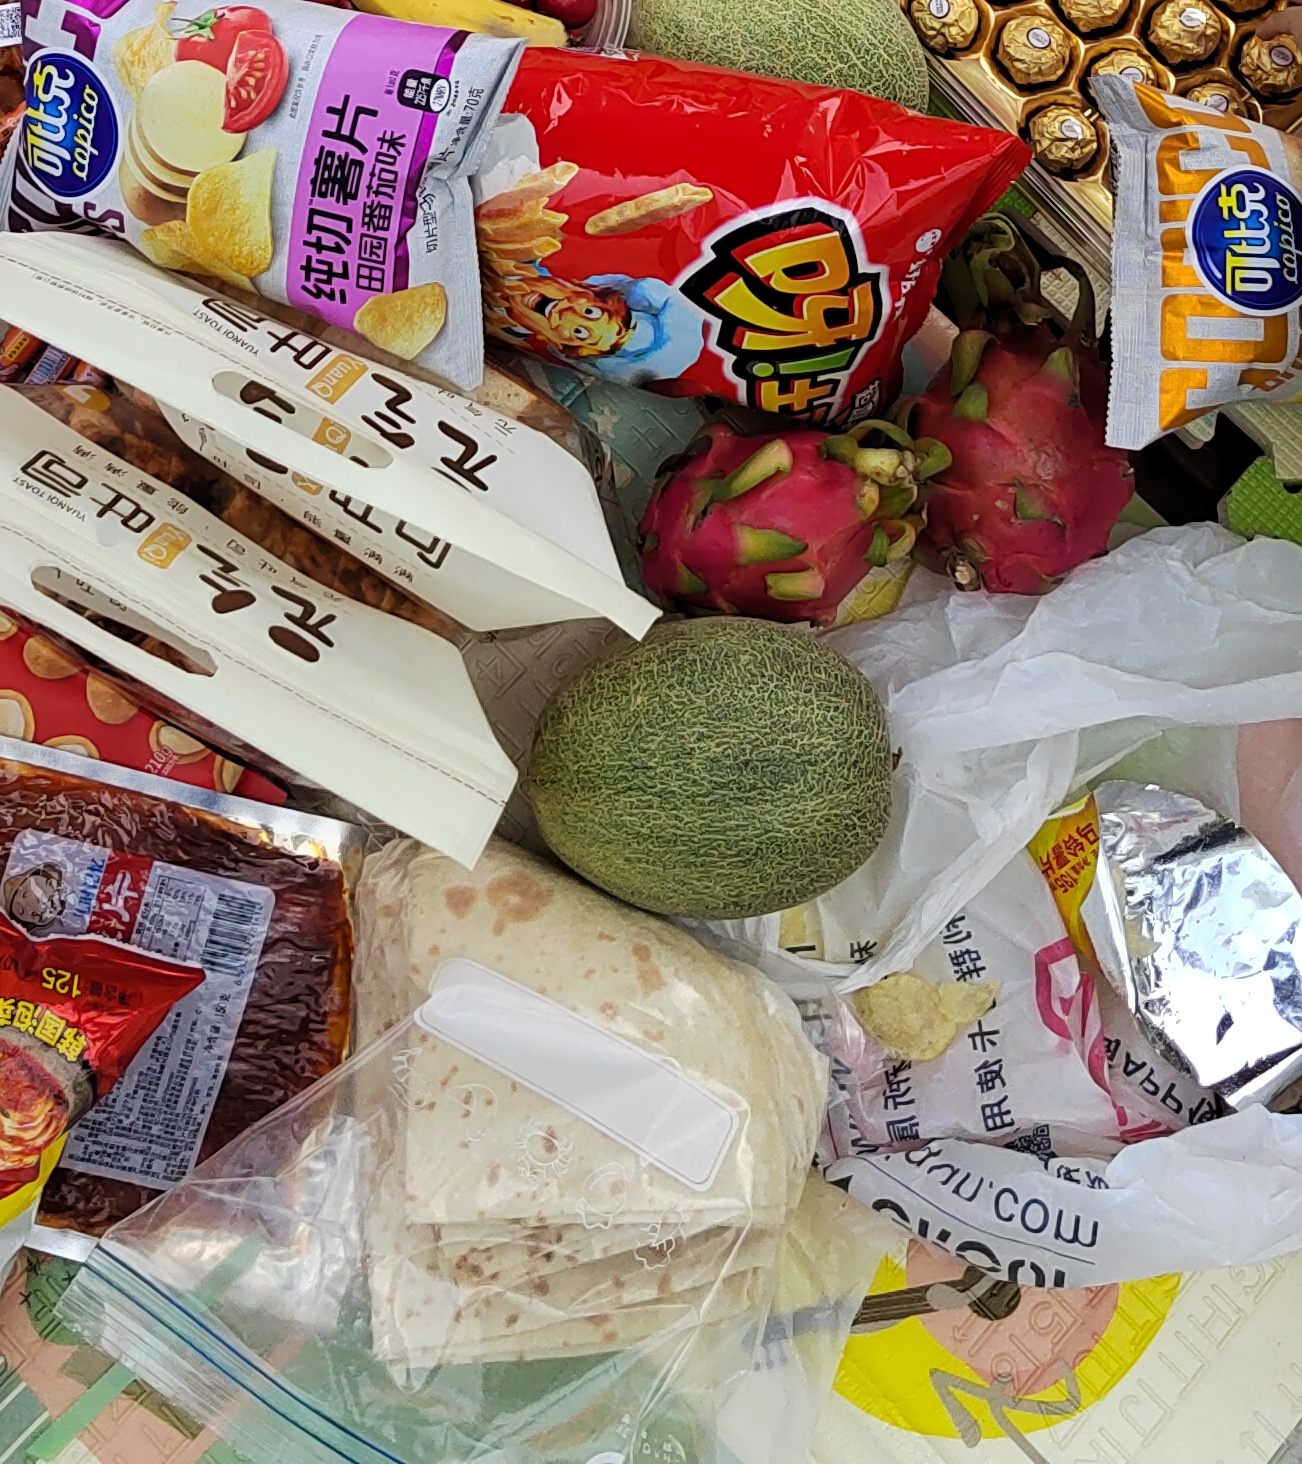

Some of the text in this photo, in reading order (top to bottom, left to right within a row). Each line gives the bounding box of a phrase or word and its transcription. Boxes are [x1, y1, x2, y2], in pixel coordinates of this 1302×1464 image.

[26, 59, 75, 177] 可比克
[72, 84, 99, 184] copico
[302, 93, 378, 305] 纯切薯片
[357, 129, 408, 293] 田园番茄味
[1218, 181, 1284, 295] 可比克
[191, 307, 226, 330] TOAST
[11, 475, 88, 523] YUANQI TOAST
[21, 448, 155, 534] 吐司
[211, 544, 339, 662] 元气
[145, 745, 173, 775] 210g
[41, 967, 81, 997] 125
